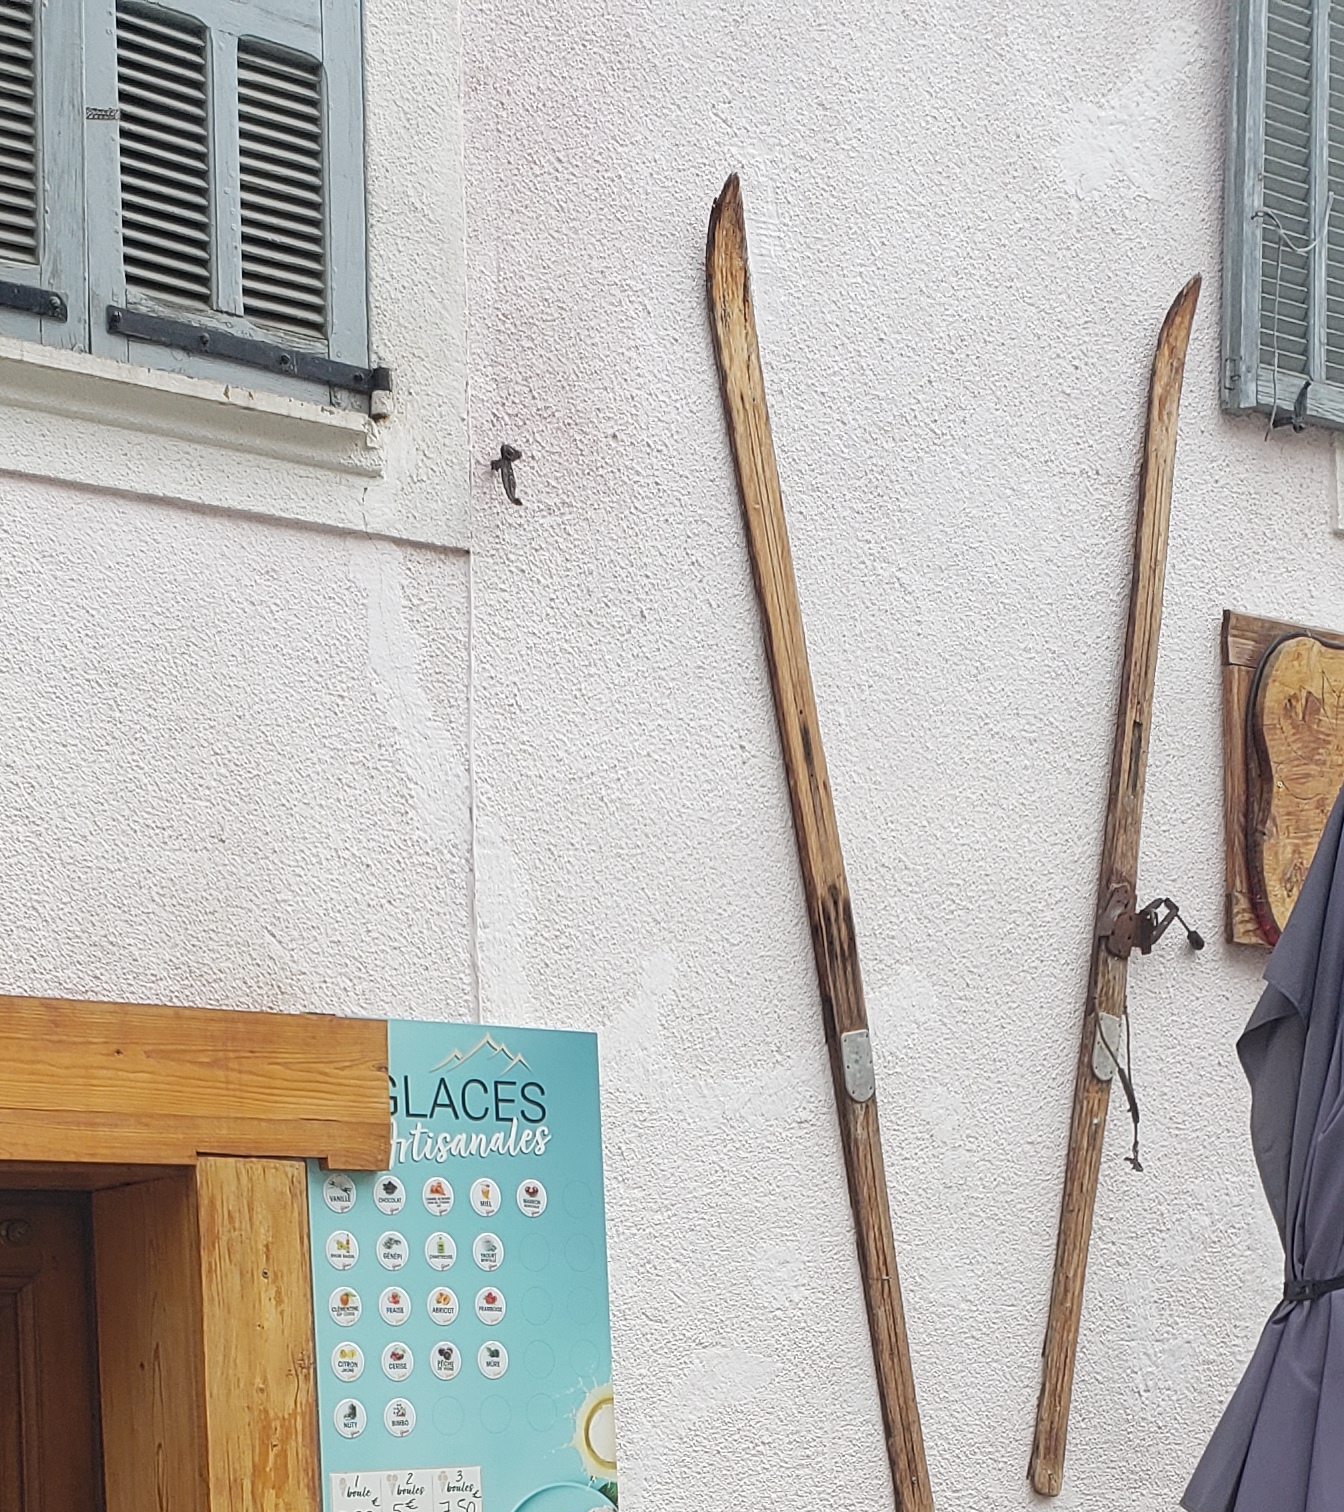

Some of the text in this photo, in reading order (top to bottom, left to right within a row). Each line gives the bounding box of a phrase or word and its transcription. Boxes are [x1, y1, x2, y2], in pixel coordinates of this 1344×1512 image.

[355, 1475, 359, 1488] 1
[406, 1472, 414, 1485] 2
[456, 1470, 463, 1482] 3
[346, 1486, 371, 1498] boule
[396, 1484, 425, 1495] boules
[446, 1482, 474, 1493] boules
